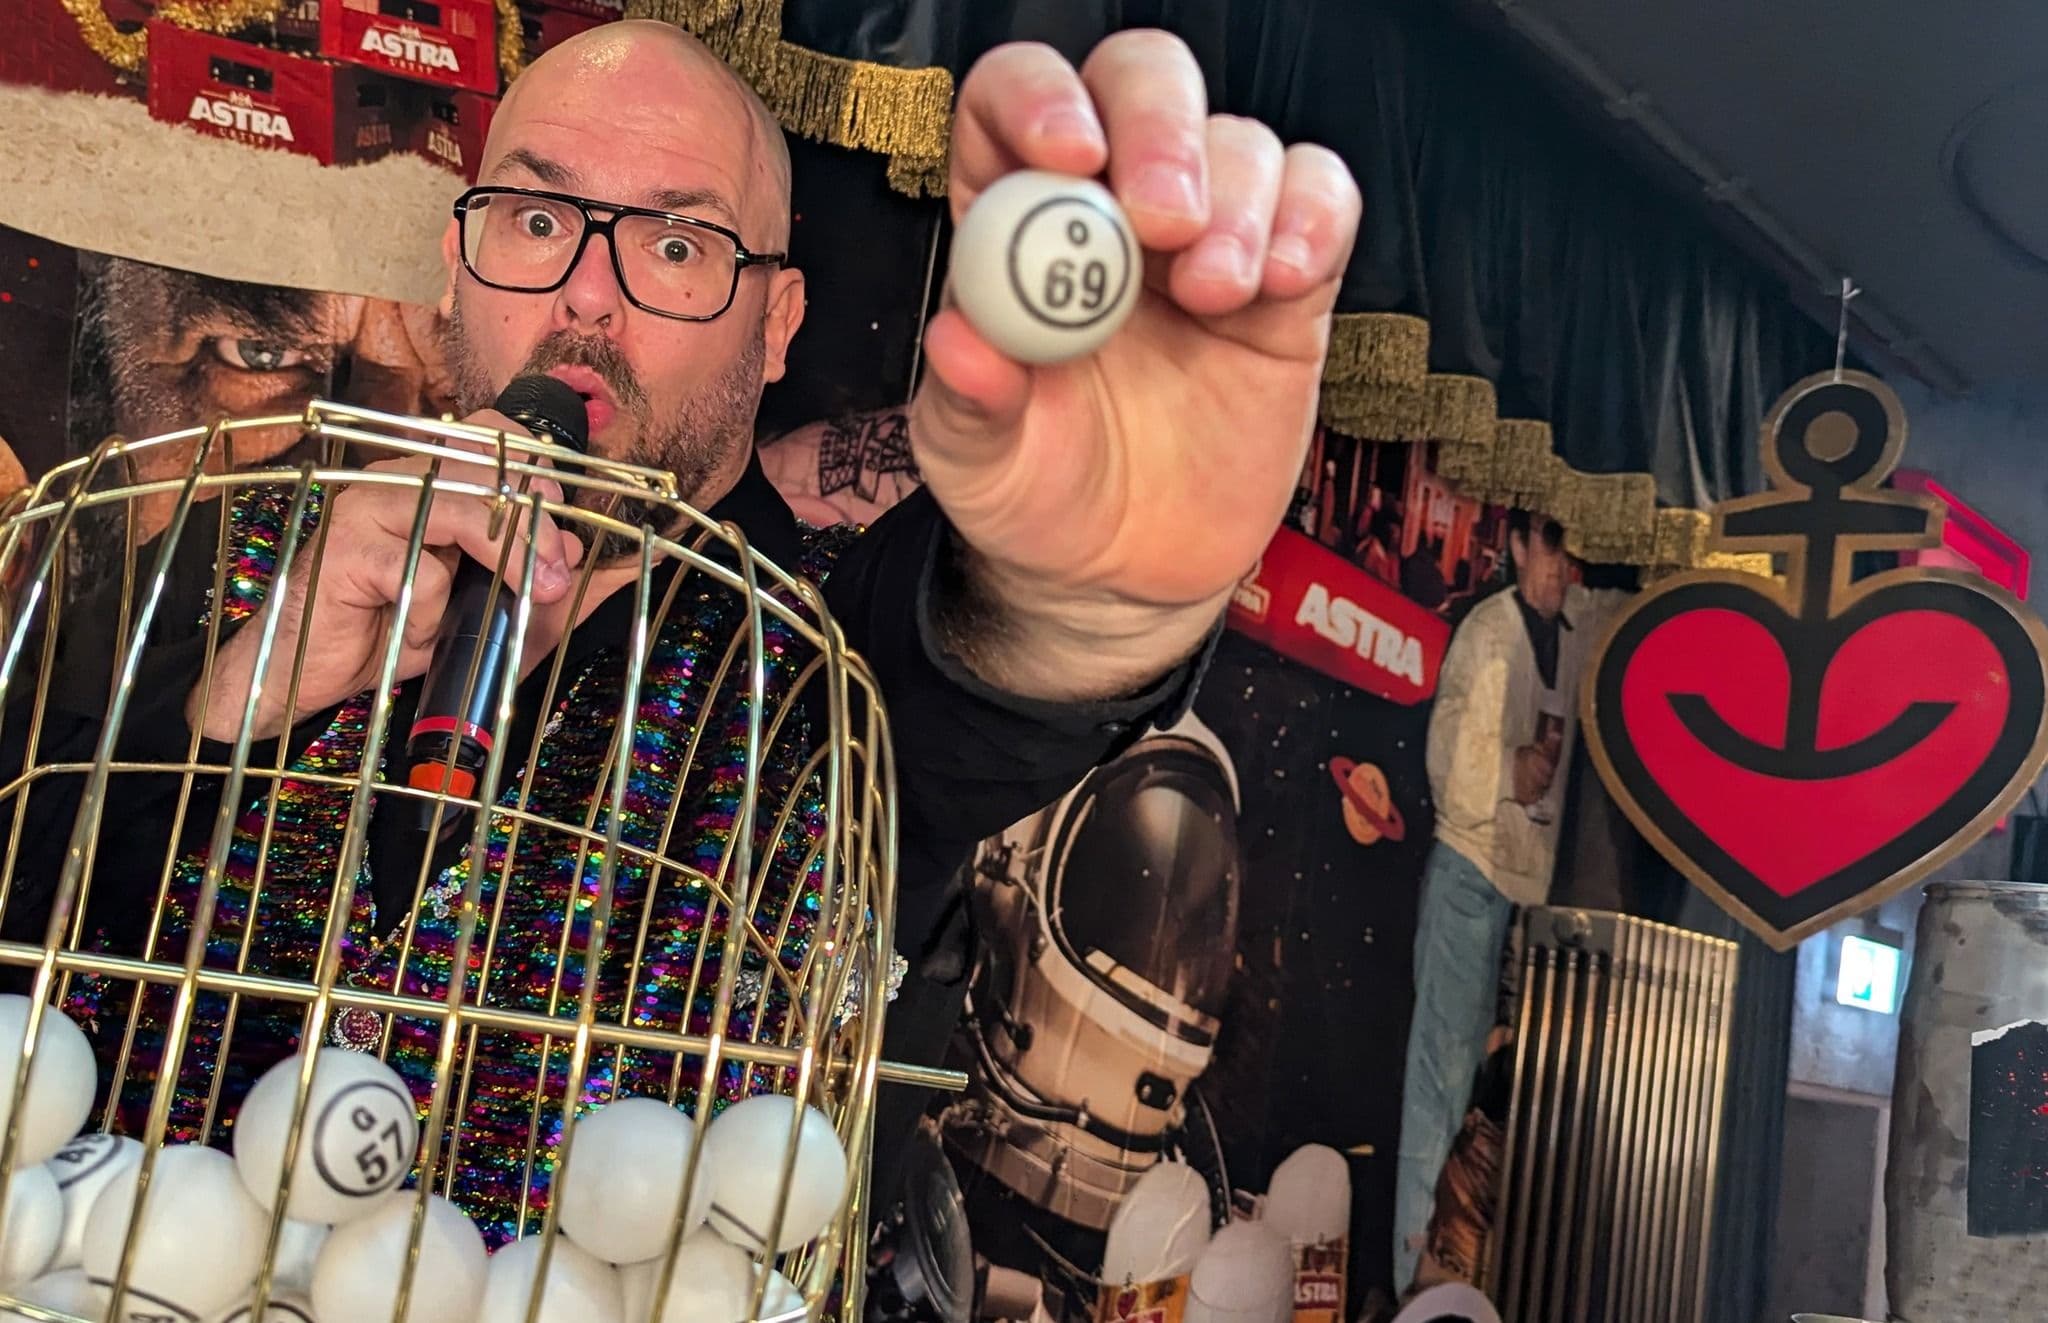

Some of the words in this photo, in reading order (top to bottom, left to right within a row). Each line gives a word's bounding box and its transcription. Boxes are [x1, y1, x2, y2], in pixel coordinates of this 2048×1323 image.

[360, 26, 461, 72] ASTRA
[188, 96, 295, 141] ASTRA
[427, 130, 463, 167] ASTRA
[1044, 259, 1107, 310] 69
[1295, 582, 1424, 687] ASTRA
[356, 1118, 403, 1185] 57
